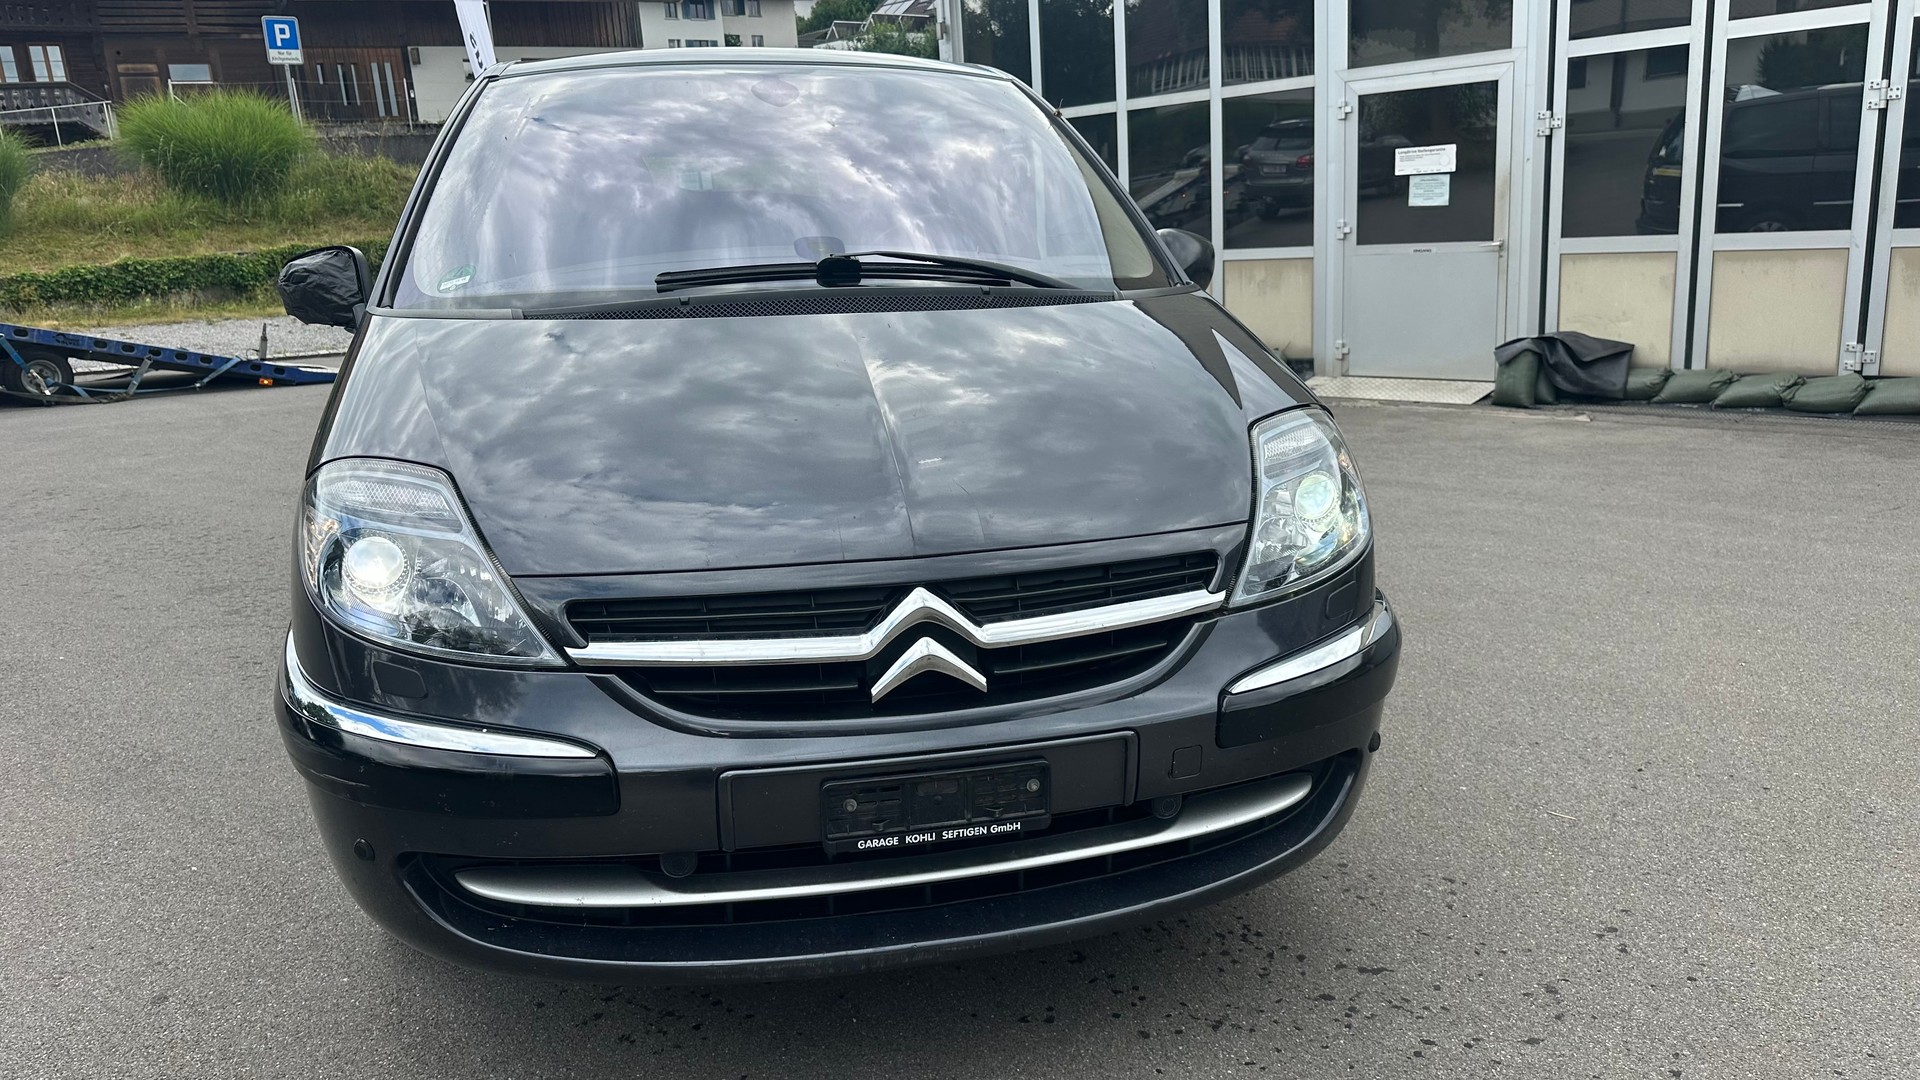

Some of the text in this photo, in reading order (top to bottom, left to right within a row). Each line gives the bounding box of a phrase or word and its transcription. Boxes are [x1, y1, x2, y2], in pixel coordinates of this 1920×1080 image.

[273, 23, 291, 47] P
[857, 822, 1021, 849] GARAGE KOHLI SEFTIGEN GmbH
